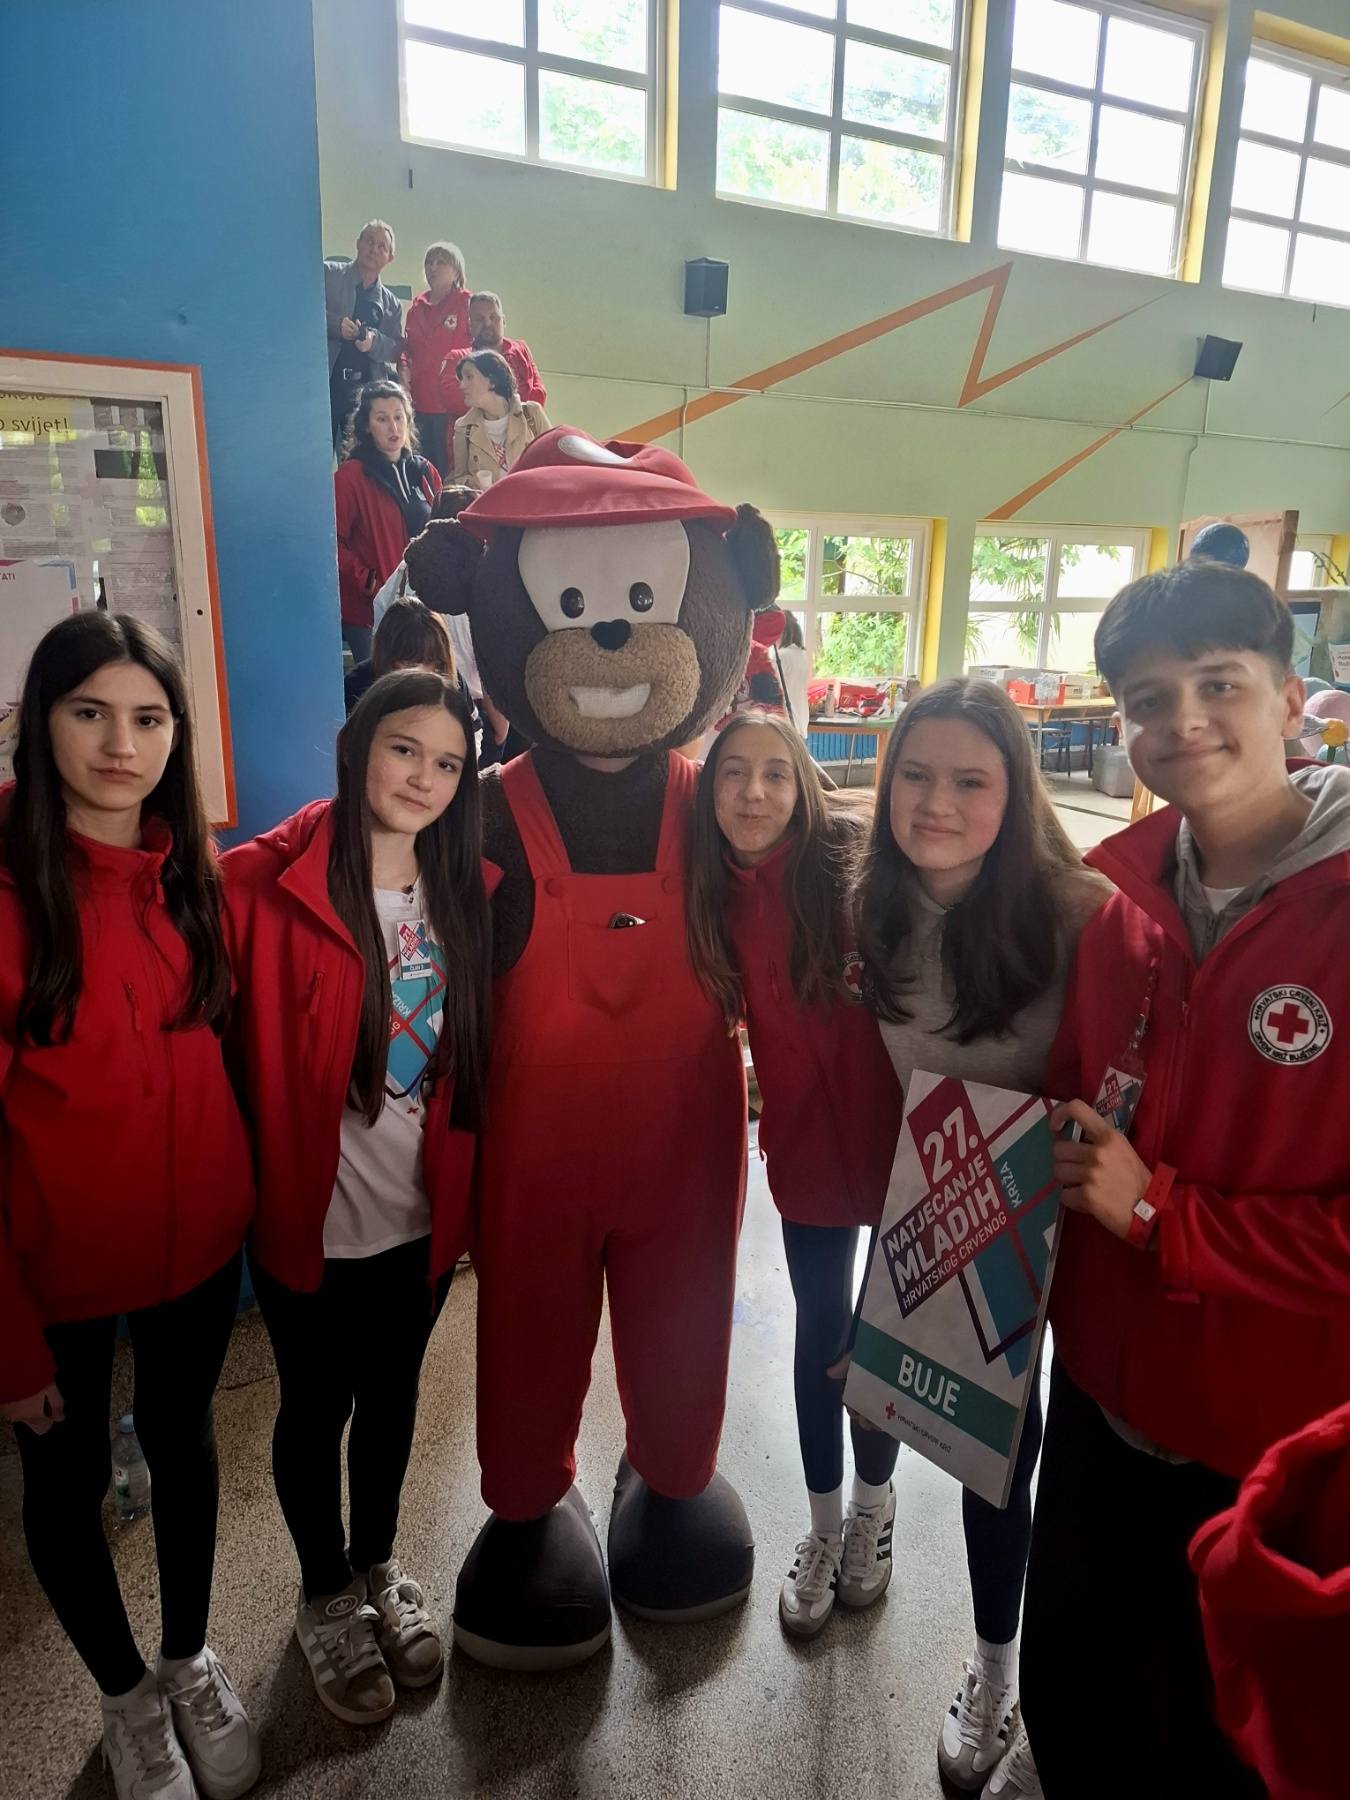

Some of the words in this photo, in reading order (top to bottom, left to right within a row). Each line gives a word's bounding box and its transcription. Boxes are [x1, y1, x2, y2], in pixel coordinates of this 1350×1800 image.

[11, 416, 69, 436] svijet!
[0, 572, 16, 581] ATI
[1254, 989, 1287, 1017] HRVATSKI
[1289, 989, 1317, 1009] CRVENI
[1314, 1008, 1328, 1027] KRIŽ
[923, 1105, 979, 1184] 27.
[886, 1153, 988, 1258] NATJECANJE
[999, 1161, 1023, 1209] KRIŽA
[894, 1176, 1001, 1293] MLADIH
[902, 1257, 958, 1310] HRVATSKOG
[959, 1210, 1007, 1261] CRVENOG
[898, 1353, 961, 1417] BUJE
